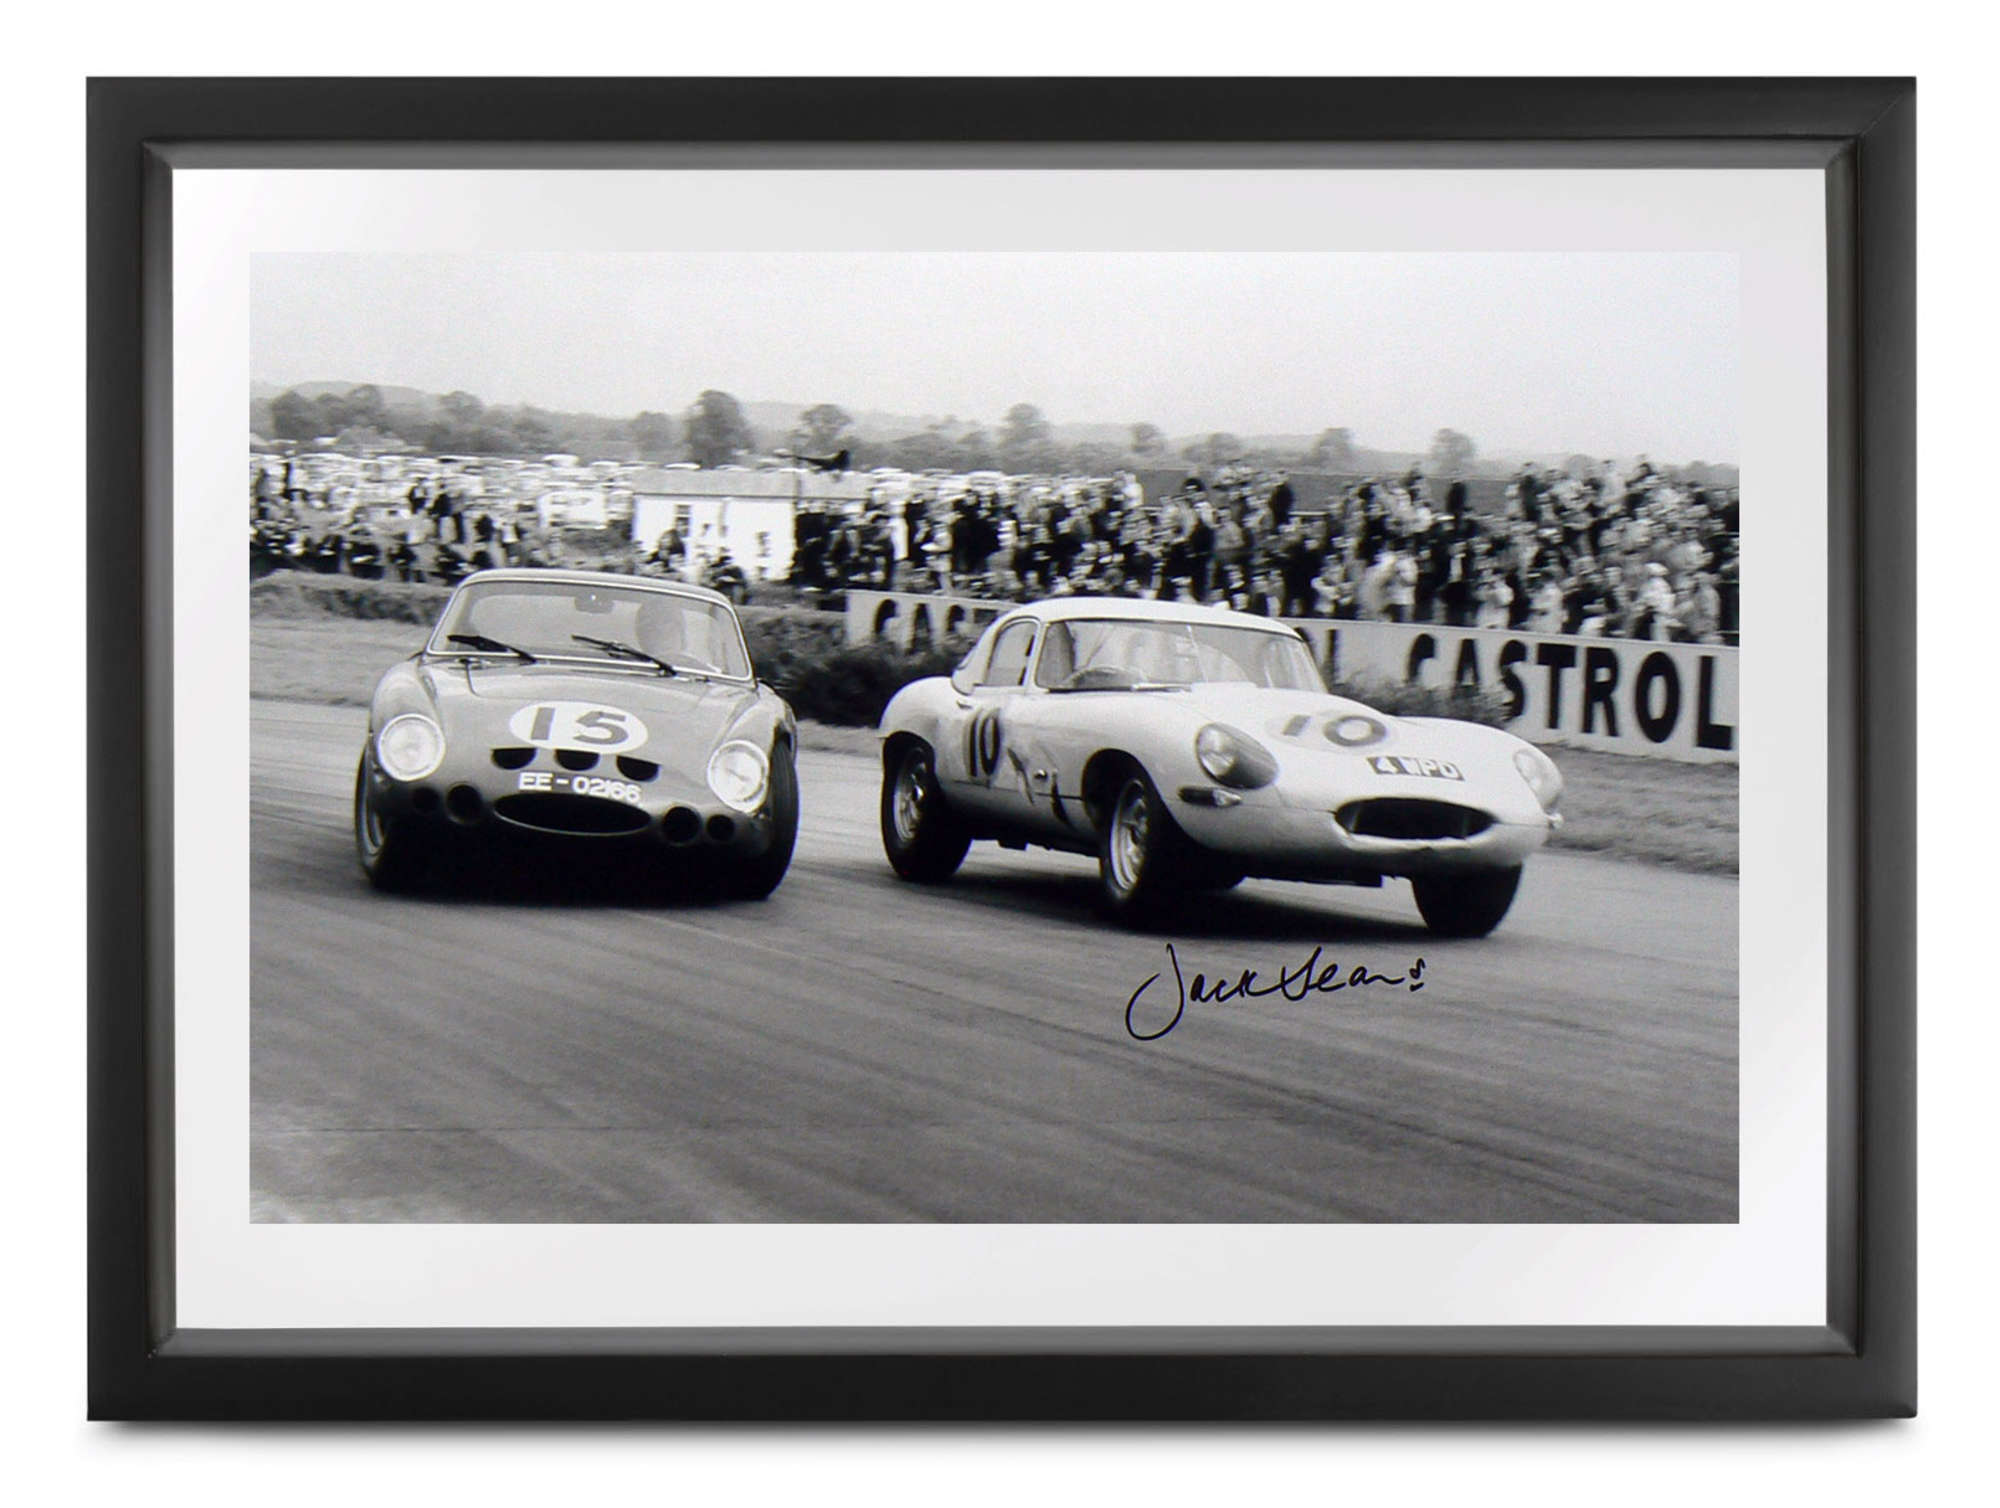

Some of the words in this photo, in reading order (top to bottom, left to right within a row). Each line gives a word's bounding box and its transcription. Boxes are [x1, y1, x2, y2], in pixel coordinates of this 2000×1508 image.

[1407, 633, 1733, 751] CASTROL
[530, 706, 629, 745] 15
[968, 709, 1001, 776] 10
[1282, 714, 1387, 747] 10
[1376, 757, 1398, 774] 4
[1125, 943, 1282, 1041] Jack
